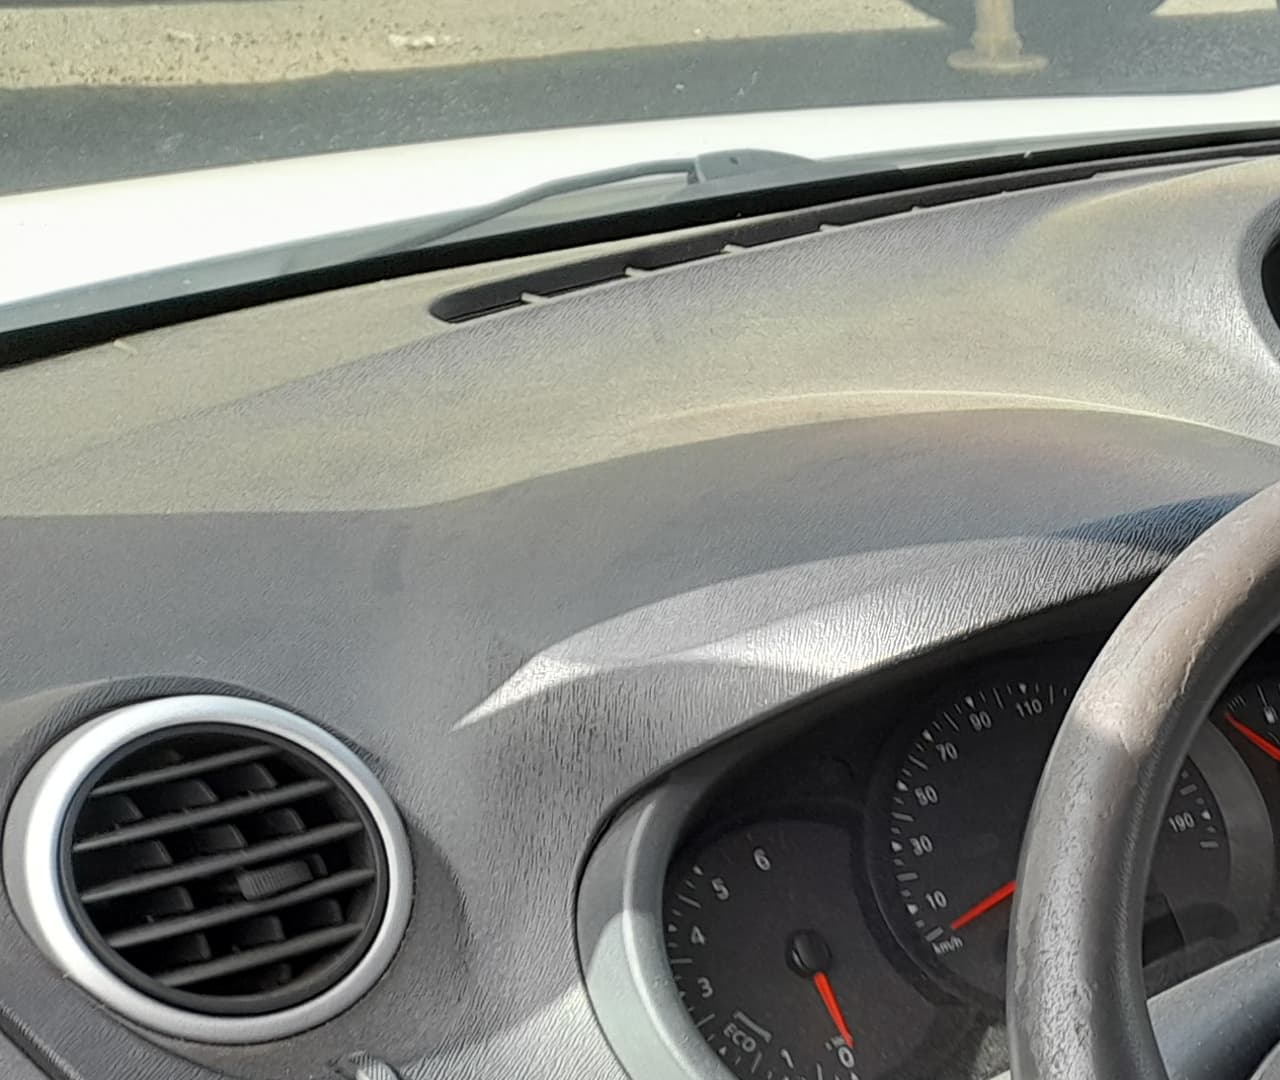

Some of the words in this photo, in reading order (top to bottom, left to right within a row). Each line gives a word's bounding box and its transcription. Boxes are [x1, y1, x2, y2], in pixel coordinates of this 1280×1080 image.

[1015, 699, 1043, 719] 110
[968, 711, 992, 731] 90
[937, 742, 959, 762] 70
[1167, 813, 1196, 832] 190
[909, 835, 934, 855] 30
[752, 848, 772, 872] 6
[711, 878, 730, 901] 5
[924, 891, 948, 911] 10
[690, 926, 707, 946] 4
[932, 935, 964, 956] km/h
[697, 977, 714, 999] 3
[722, 1023, 758, 1055] ECO
